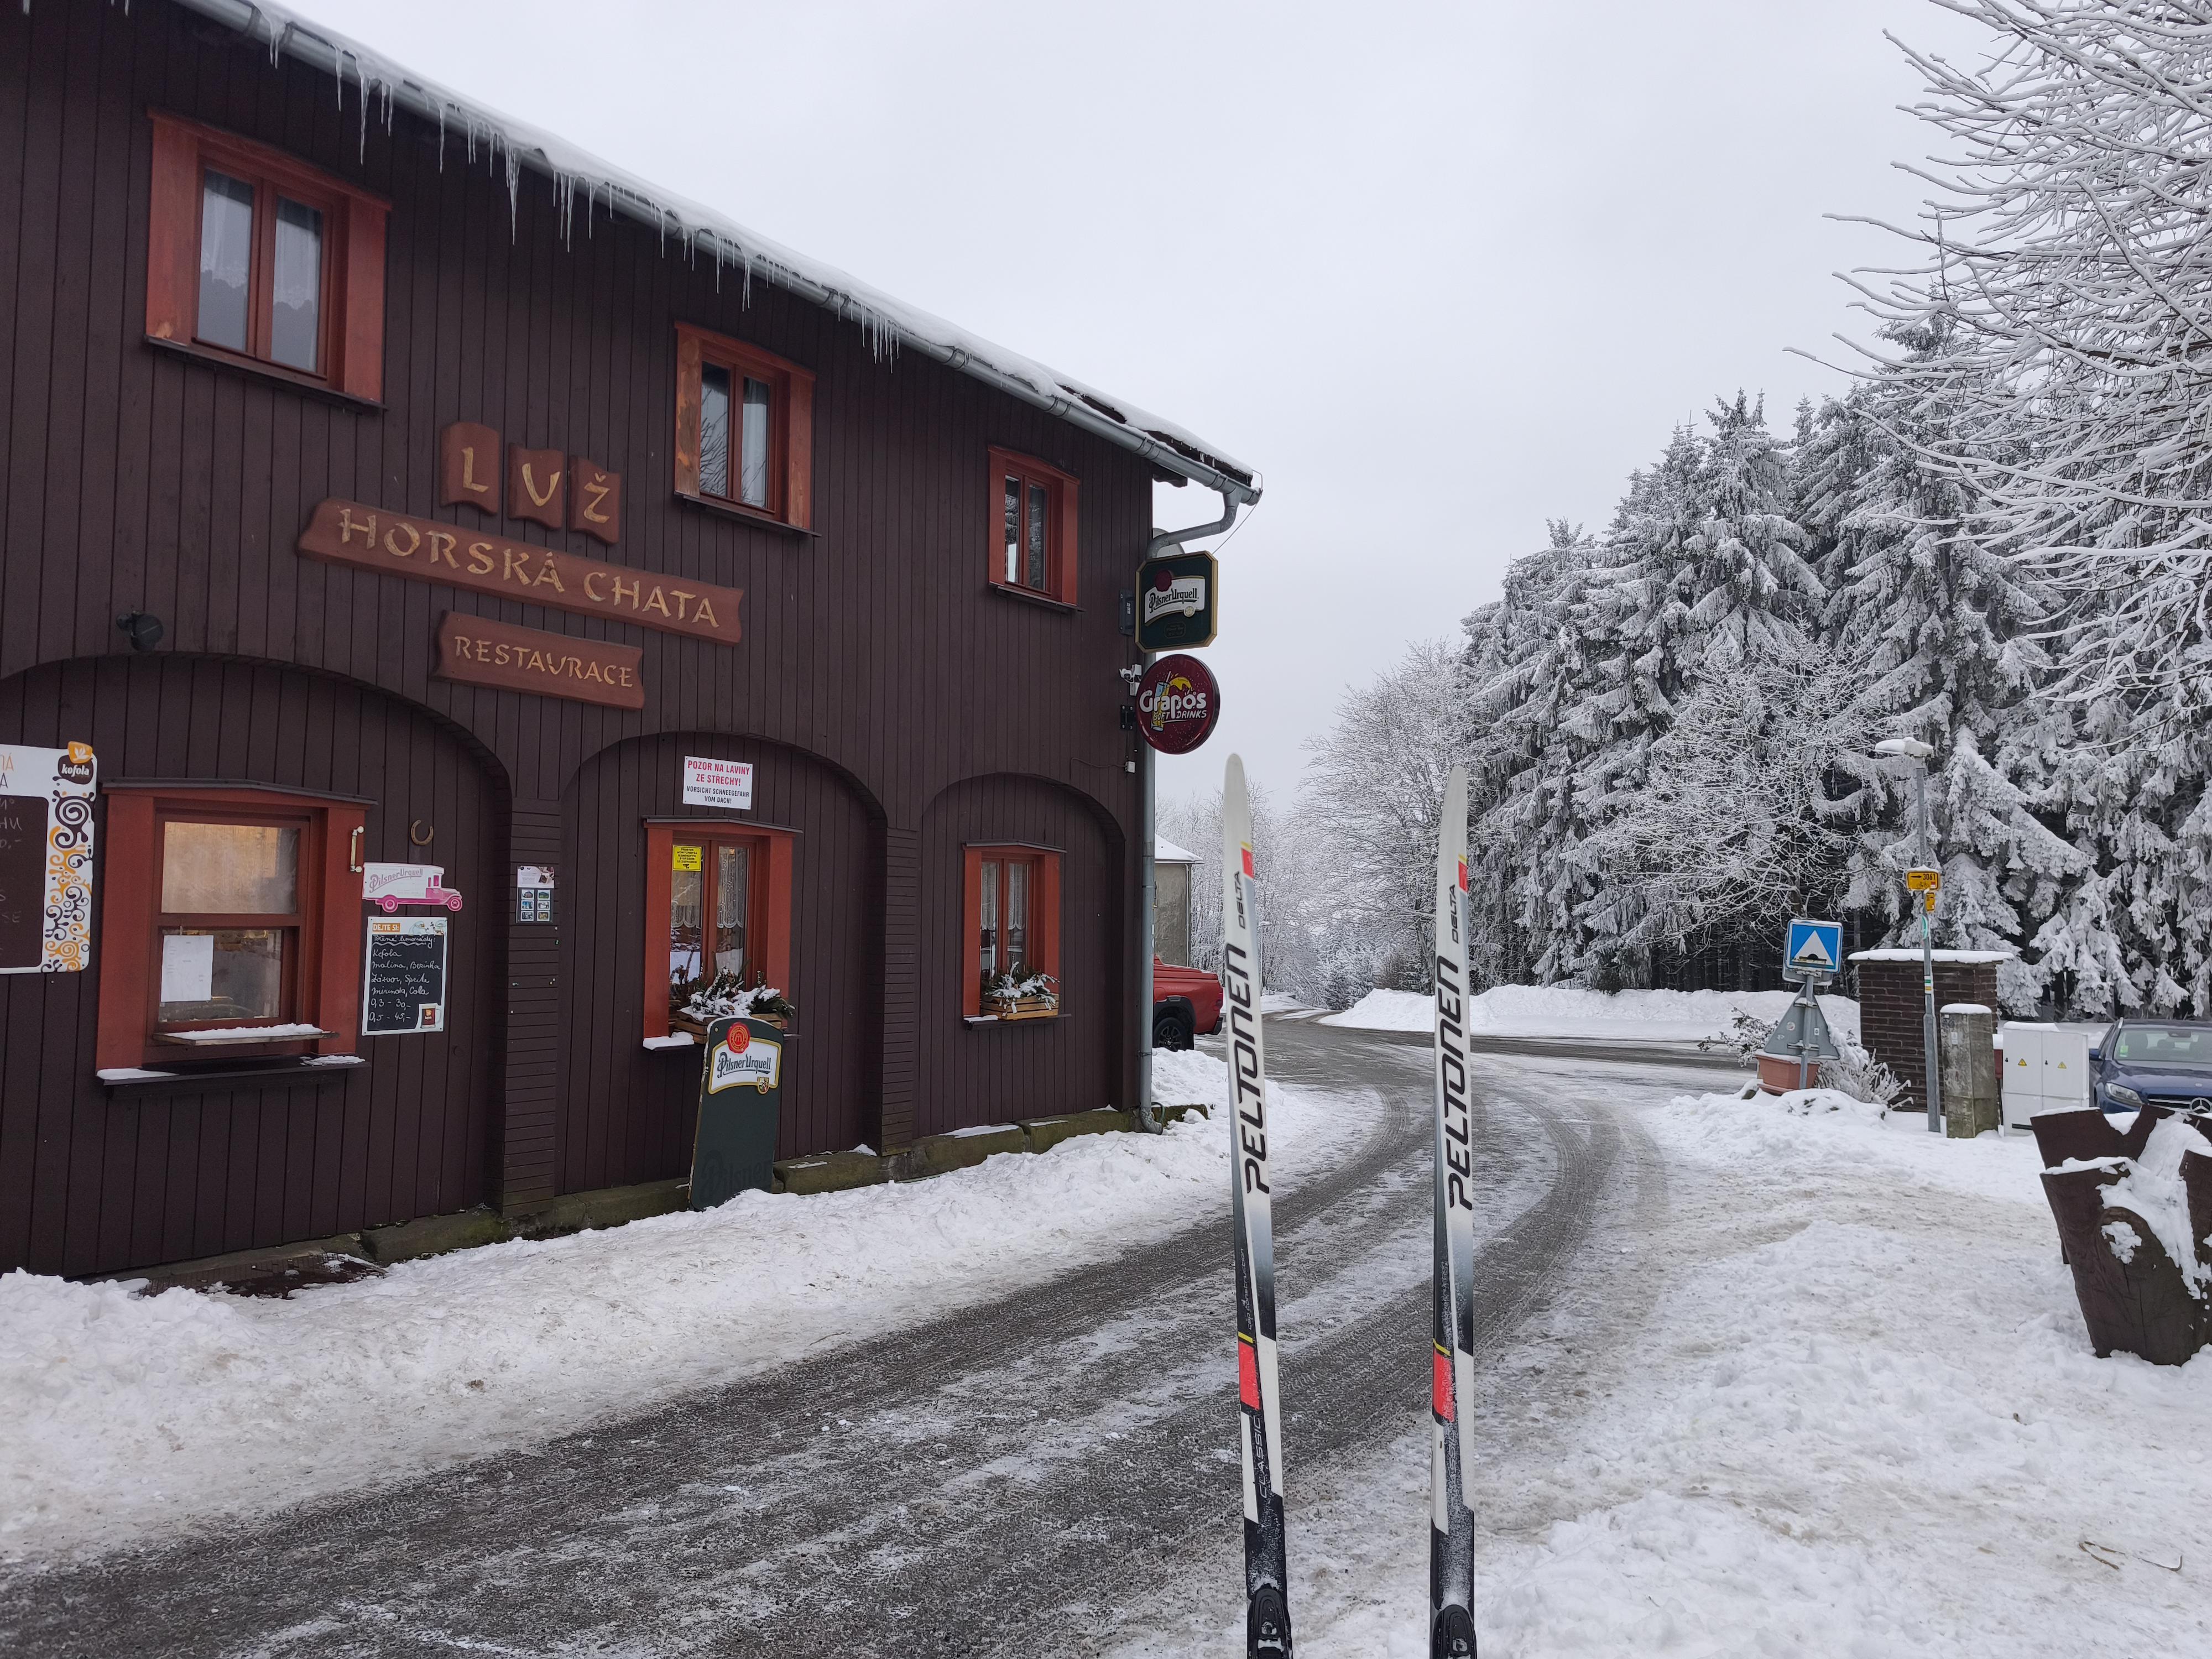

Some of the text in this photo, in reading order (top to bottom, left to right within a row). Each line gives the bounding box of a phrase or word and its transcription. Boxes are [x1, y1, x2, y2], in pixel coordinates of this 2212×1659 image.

[461, 446, 611, 524] LUŽ
[339, 508, 720, 629] HORSKÁ CHATA
[1149, 592, 1172, 613] Pilsner
[1171, 588, 1197, 604] Urquell
[455, 635, 633, 688] RESTAURACE
[1139, 690, 1207, 719] Grapos
[1154, 710, 1207, 721] SOFT DRINKS
[61, 764, 90, 777] kofola
[688, 760, 750, 775] POZOR NA LAVINY
[696, 773, 741, 786] ZE STŘECHY!
[687, 785, 749, 797] VORSICHT SCHNEEGEFAHR
[369, 872, 400, 893] Pilsner
[400, 868, 423, 879] Urquell
[1233, 870, 1246, 930] DELTA
[1450, 884, 1459, 945] DELTA
[409, 985, 429, 995] Cola
[717, 1051, 771, 1078] Pilsner Urquell
[1253, 1415, 1267, 1498] CLASSIC
